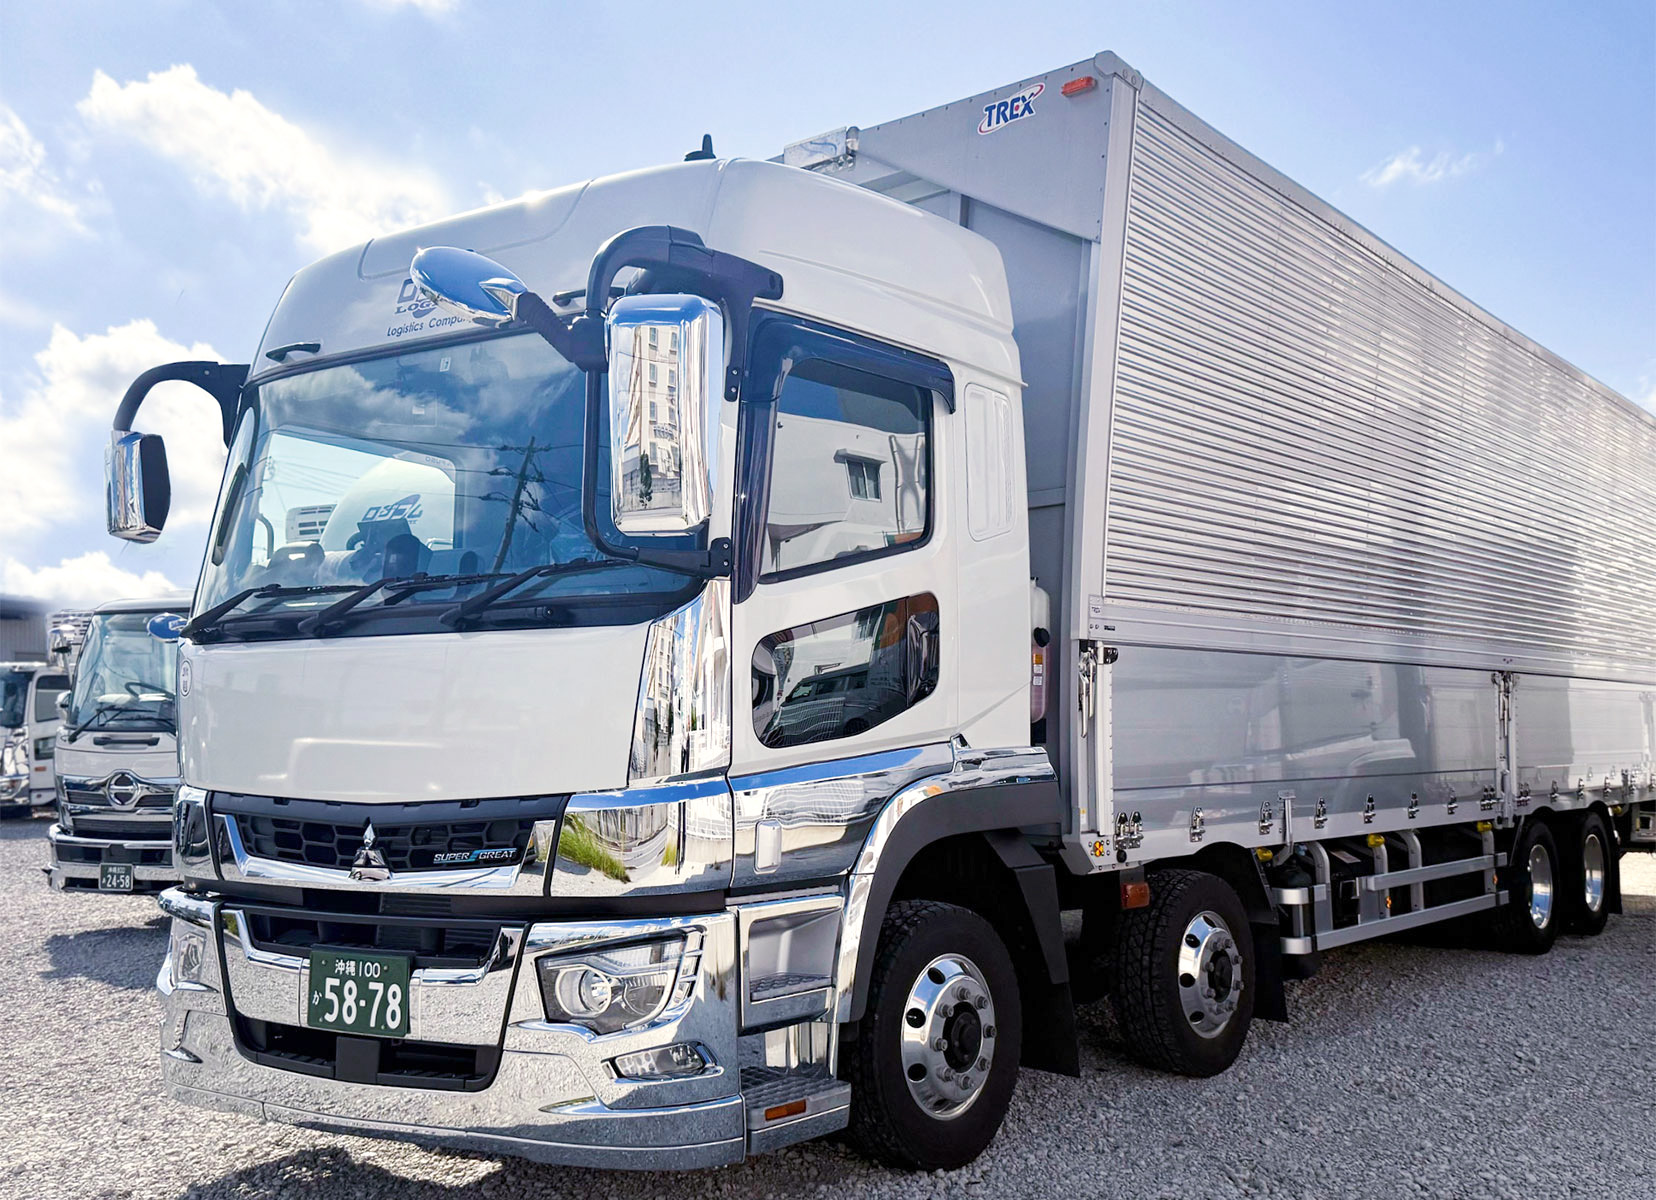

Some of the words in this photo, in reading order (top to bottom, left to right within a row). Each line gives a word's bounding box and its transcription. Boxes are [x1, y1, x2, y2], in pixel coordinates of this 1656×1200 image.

[985, 92, 1034, 127] TREX
[387, 320, 424, 337] Logistics
[434, 852, 470, 861] SUPER
[478, 850, 516, 860] GREAT
[106, 874, 131, 889] 24-58
[324, 977, 402, 1030] 58-78
